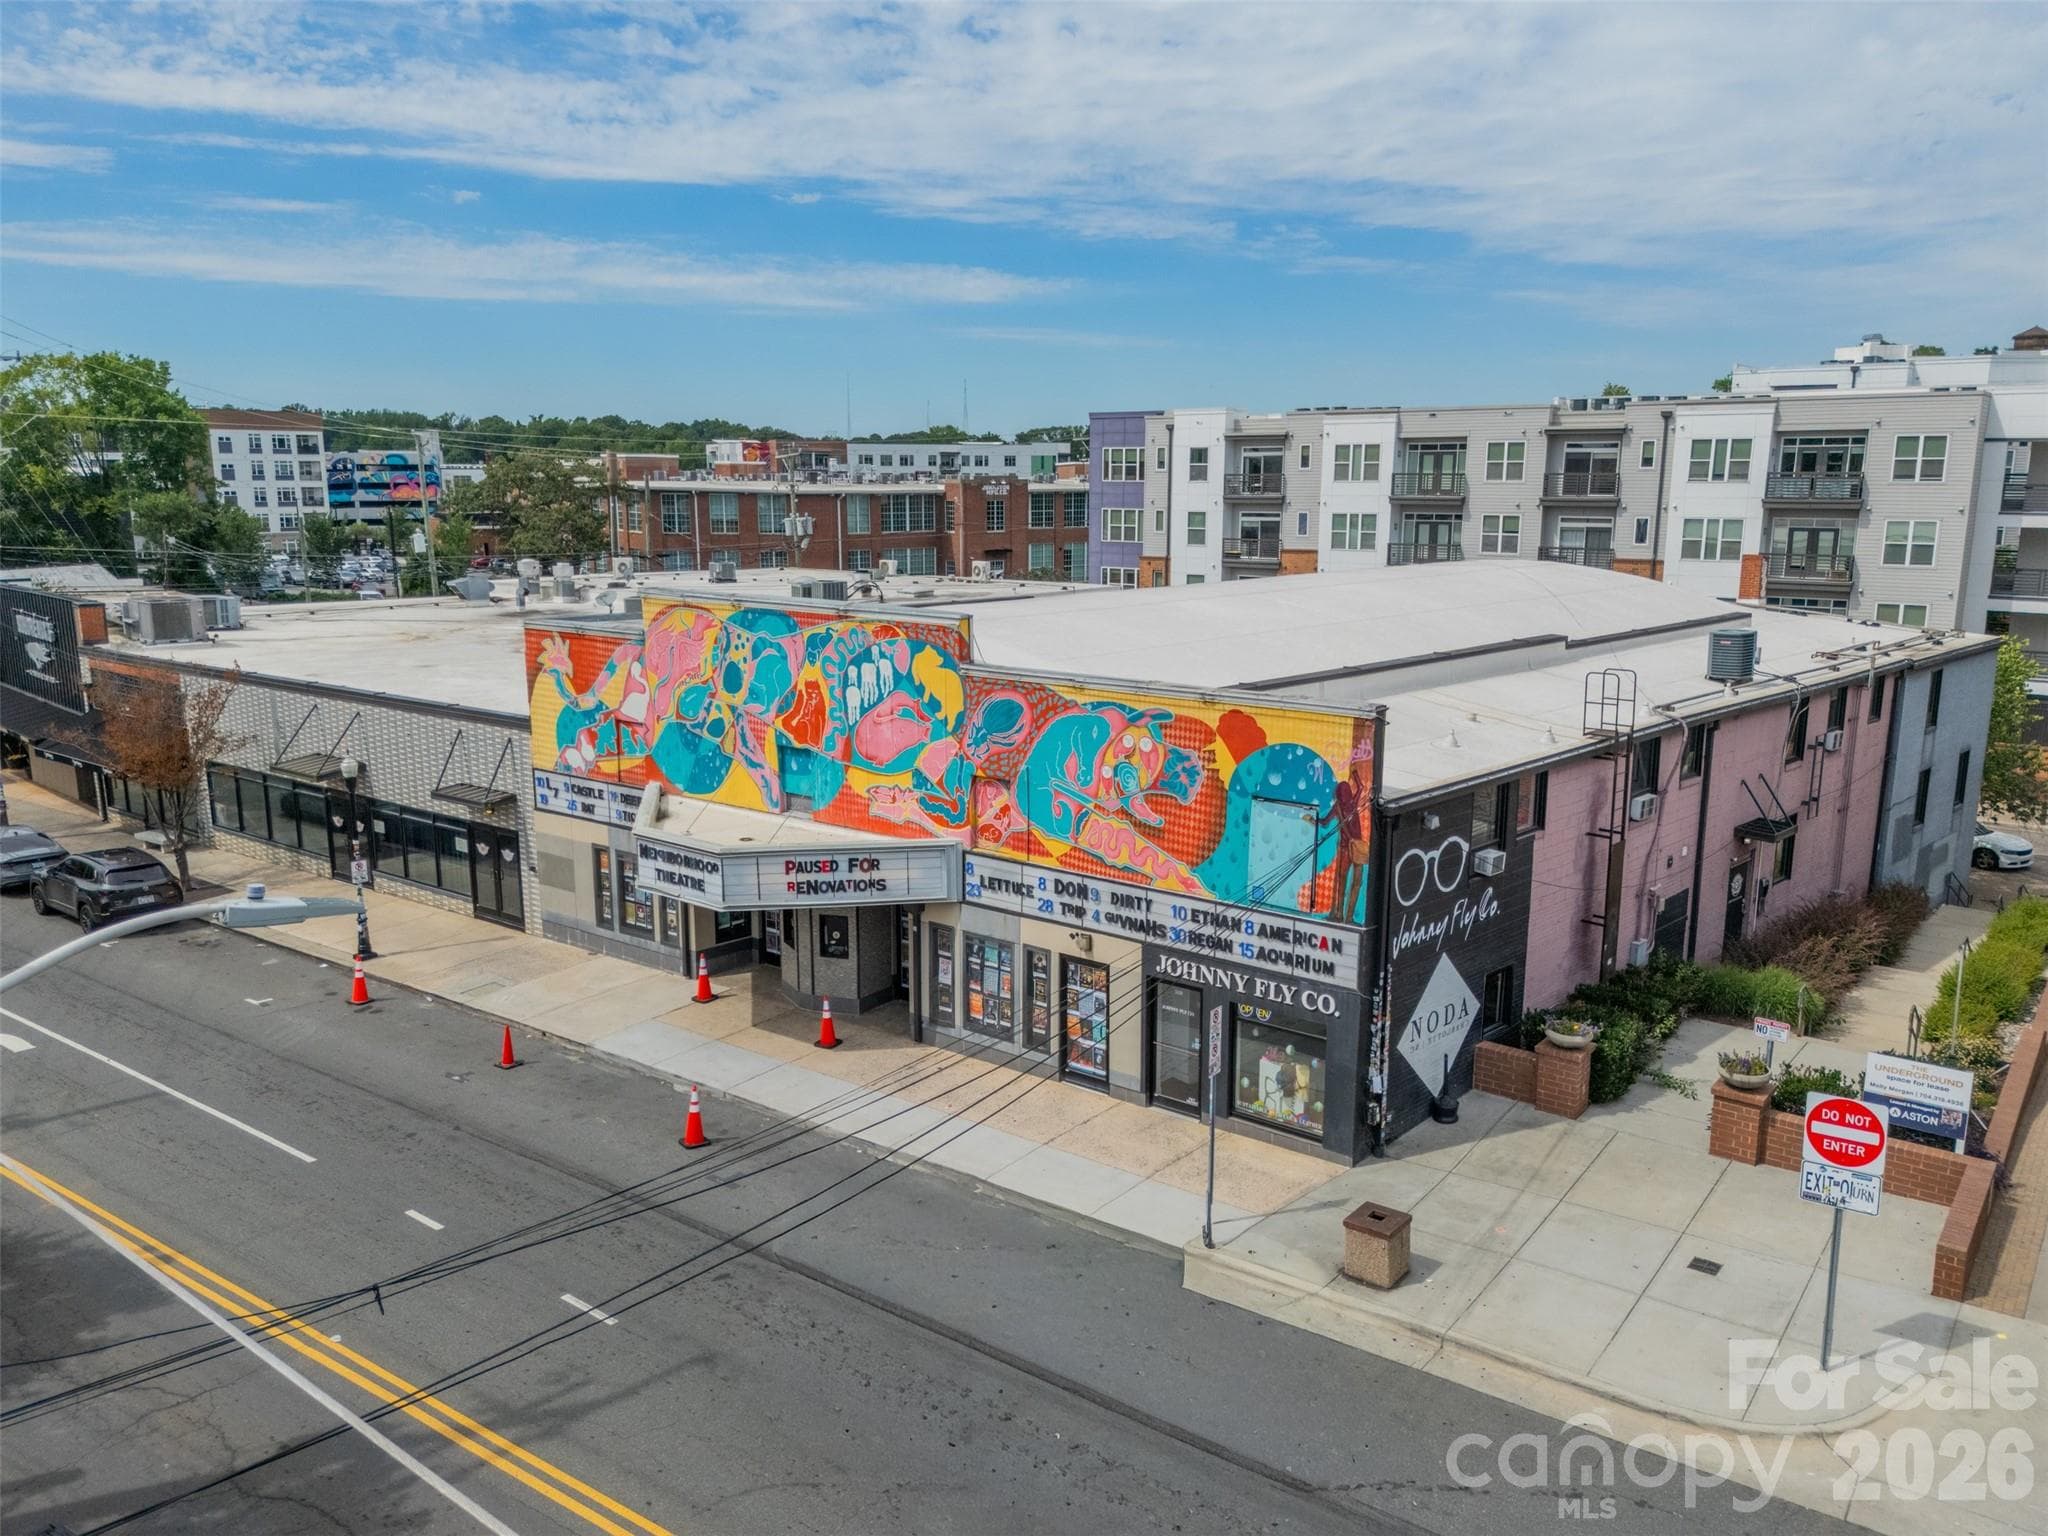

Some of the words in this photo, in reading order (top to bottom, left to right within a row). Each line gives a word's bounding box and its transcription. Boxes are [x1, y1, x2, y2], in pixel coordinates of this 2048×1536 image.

[571, 783, 604, 800] CASTLE
[784, 860, 839, 875] PAUSED
[848, 857, 880, 873] FOR
[966, 862, 974, 875] 8
[655, 868, 706, 893] THEATRE
[787, 879, 887, 895] RENOVATIONS
[966, 882, 981, 897] 23
[980, 874, 1035, 898] LETTUCE
[1038, 877, 1046, 891] 8
[1054, 878, 1088, 900] DON
[1038, 898, 1054, 913] 28
[1060, 902, 1087, 918] TRIP
[1090, 888, 1100, 902] 9
[1110, 892, 1152, 912] DIRTY
[1091, 909, 1100, 923] 4
[1104, 912, 1167, 938] GUVNAHS
[1171, 904, 1187, 921] 10
[1191, 909, 1241, 933] ETHAN
[1393, 912, 1449, 960] Johnny
[1450, 898, 1477, 941] Fly
[1479, 886, 1500, 920] Co.
[1169, 926, 1186, 943] 30
[1188, 930, 1233, 954] REGAN
[1244, 920, 1254, 936] 8
[1257, 923, 1342, 954] AMERICAN
[1238, 942, 1254, 960] 15
[1255, 946, 1335, 976] AQUARIUM
[1156, 954, 1249, 994] JOHNNY
[1253, 977, 1298, 1005] FLY
[1301, 990, 1341, 1018] CO.
[1410, 996, 1469, 1043] NODA
[1756, 1024, 1768, 1035] NO
[1874, 1063, 1964, 1089] UNDERGROUND
[1886, 1075, 1912, 1084] space
[1927, 1083, 1950, 1092] lease
[1821, 1108, 1839, 1121] DO
[1845, 1113, 1872, 1128] NOT
[1901, 1111, 1938, 1126] ASTON
[1823, 1138, 1866, 1158] ENTER
[1805, 1172, 1834, 1194] EXIT
